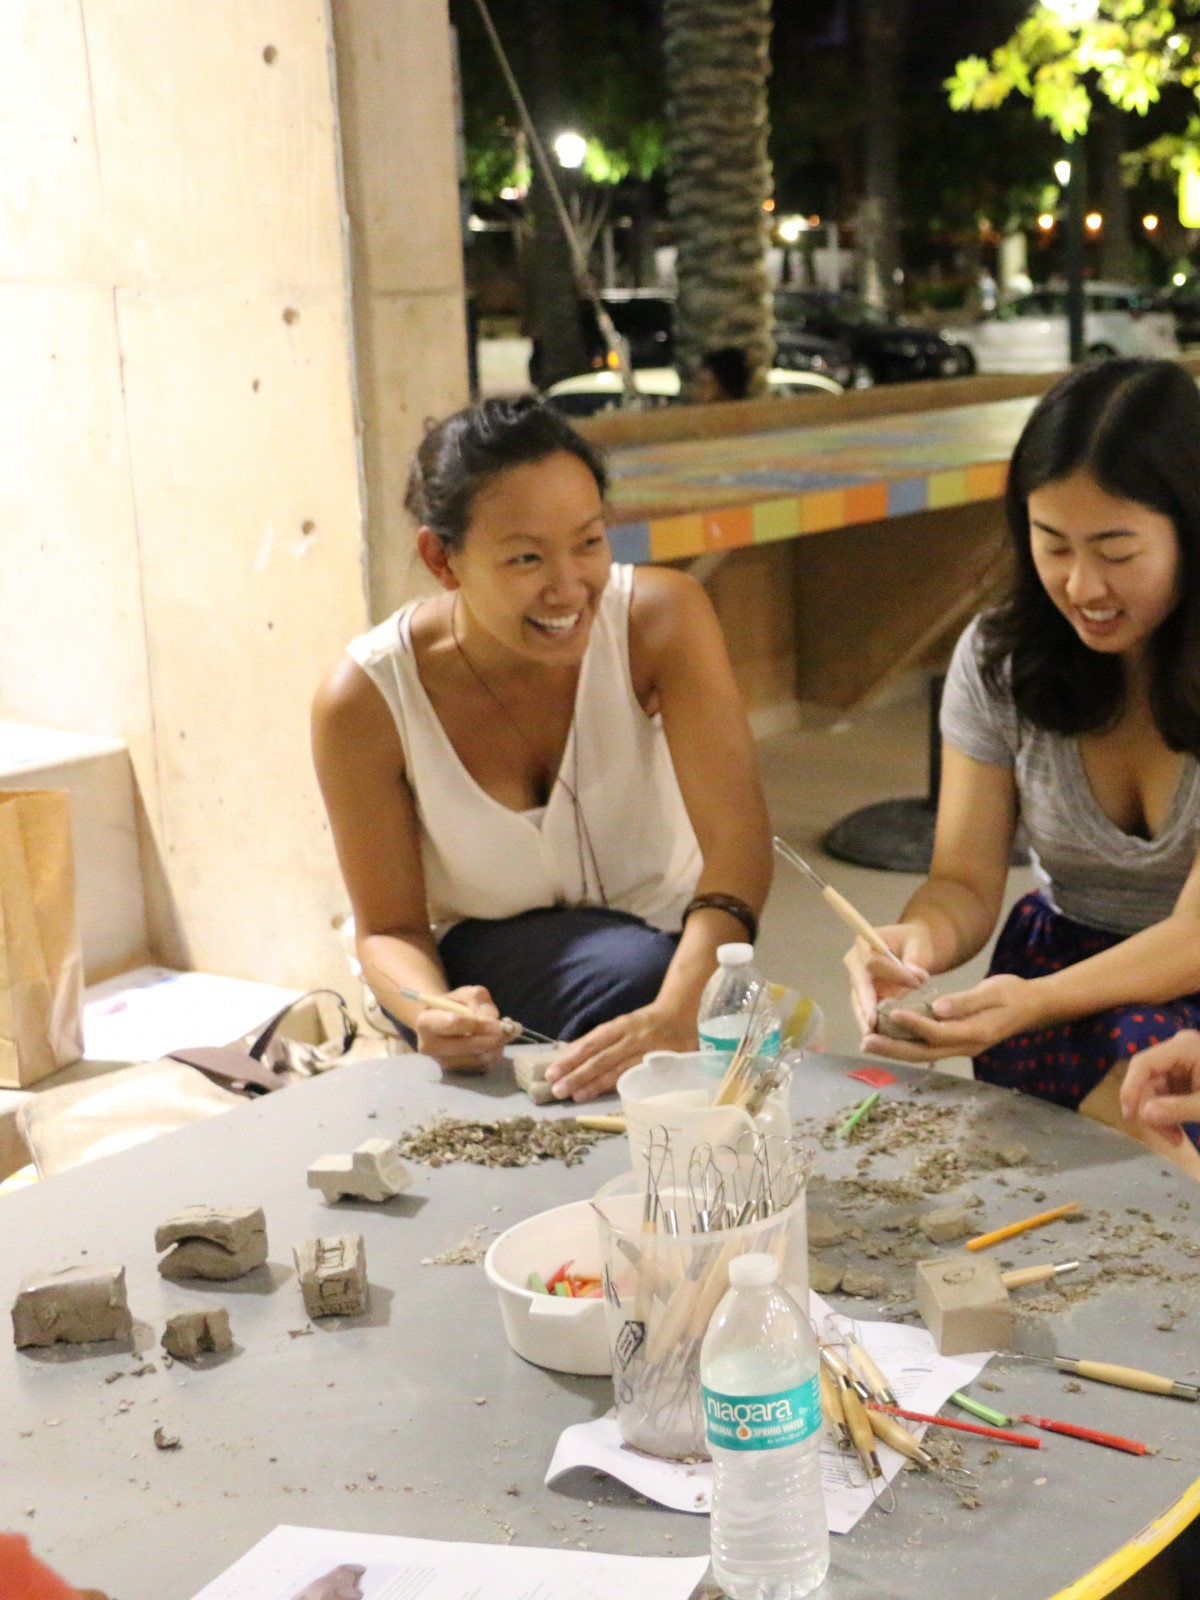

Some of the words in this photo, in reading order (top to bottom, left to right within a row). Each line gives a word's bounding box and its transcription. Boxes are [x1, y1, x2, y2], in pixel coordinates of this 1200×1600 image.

[707, 1397, 792, 1422] niagara
[753, 1425, 781, 1436] SPRING
[782, 1418, 804, 1432] WATER
